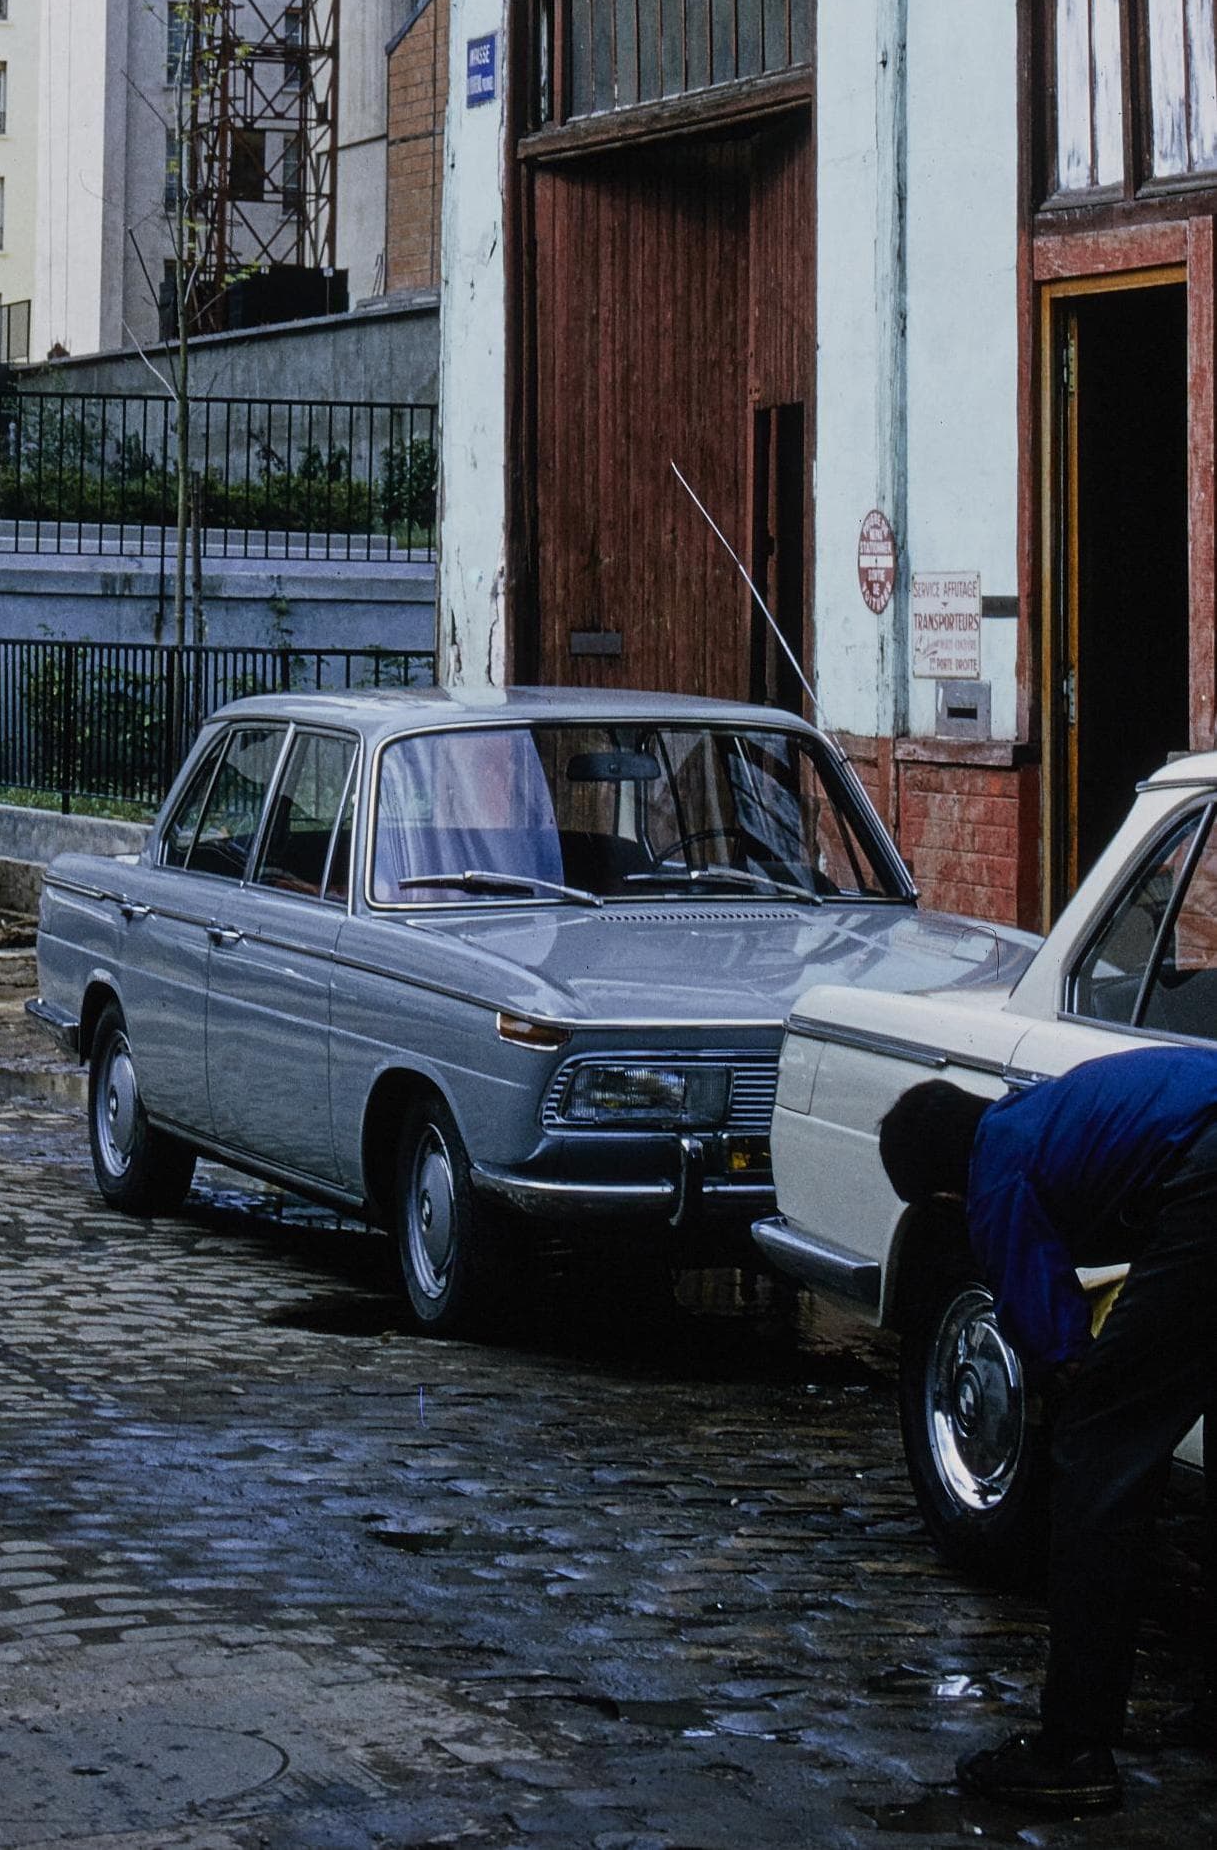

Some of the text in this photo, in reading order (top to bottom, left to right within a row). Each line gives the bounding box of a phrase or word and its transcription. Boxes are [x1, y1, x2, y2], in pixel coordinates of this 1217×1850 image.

[913, 580, 978, 598] SERVICE AFFUTAGE
[913, 613, 979, 631] TRANSPORTEURS
[955, 658, 978, 671] DROITE
